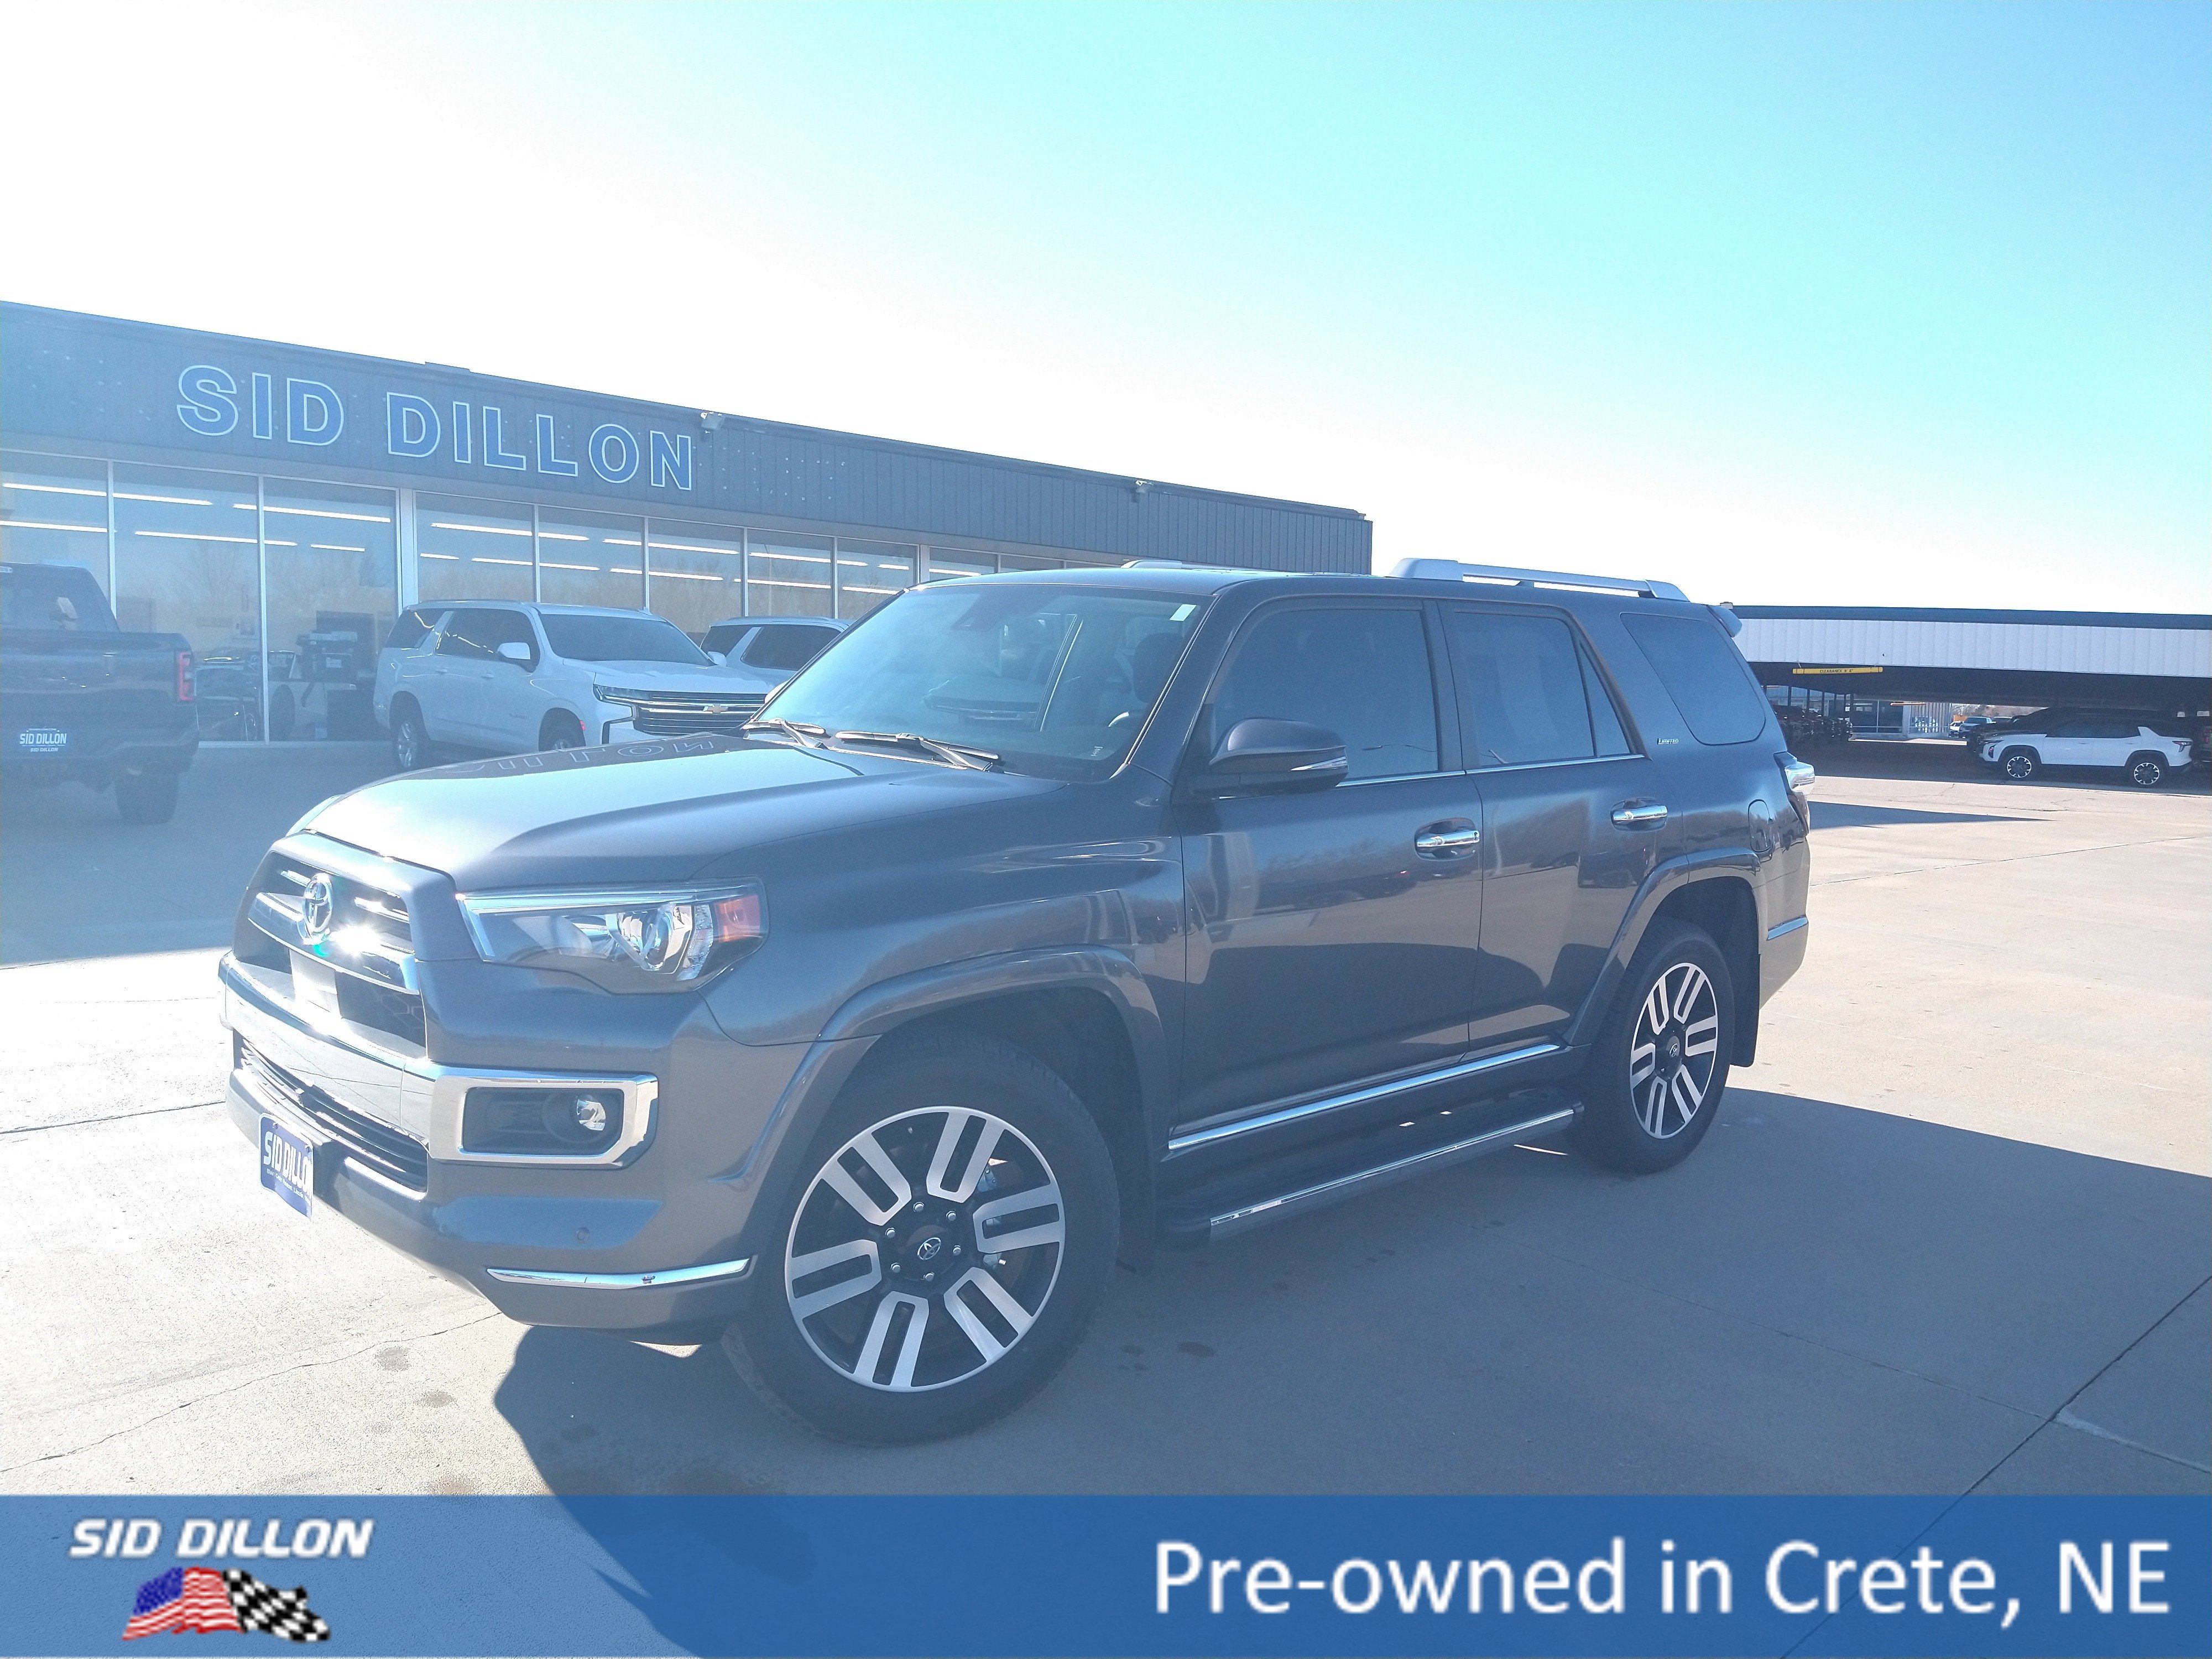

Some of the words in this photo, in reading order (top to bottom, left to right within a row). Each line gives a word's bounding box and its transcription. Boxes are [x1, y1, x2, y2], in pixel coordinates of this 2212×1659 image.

[177, 364, 345, 446] SID
[387, 392, 692, 491] DILLON
[19, 733, 34, 744] SID
[36, 733, 67, 744] DILLON
[263, 1131, 283, 1172] SID
